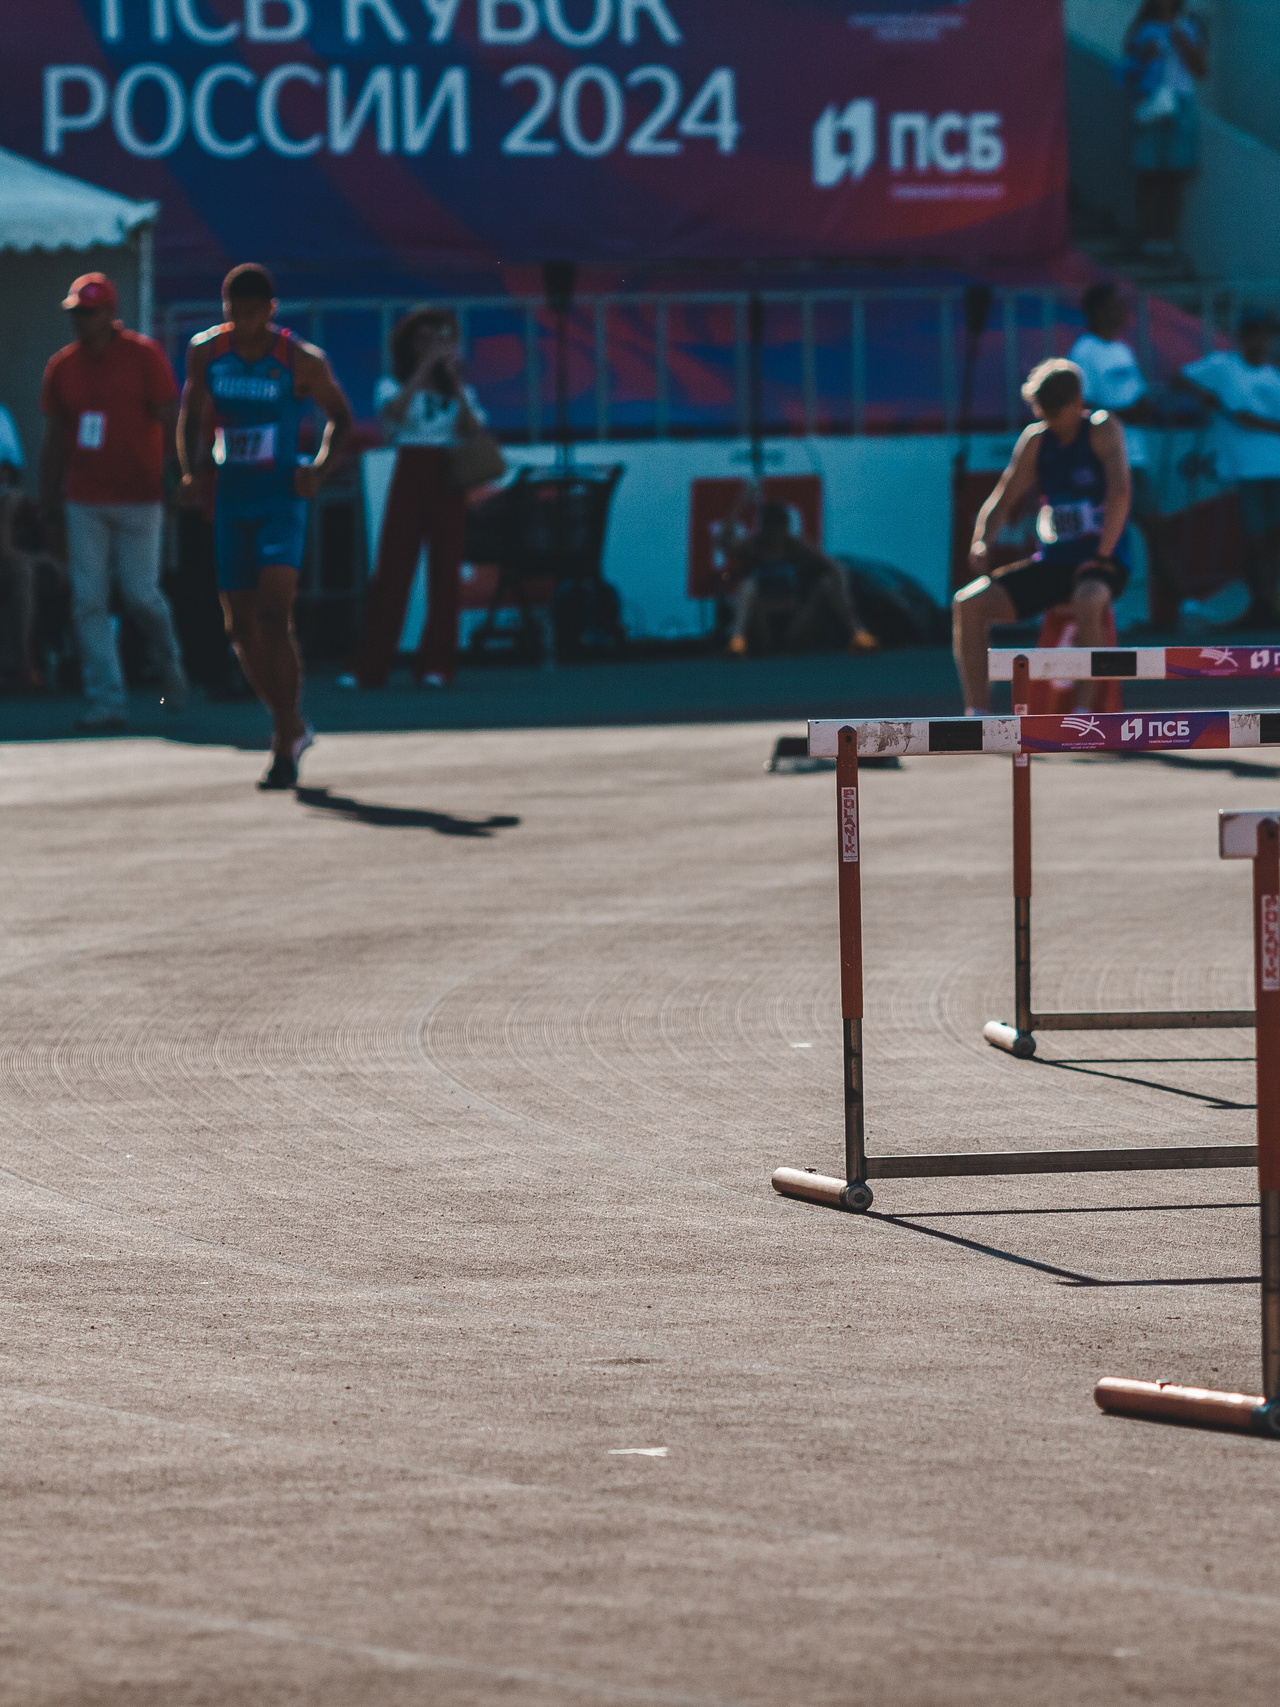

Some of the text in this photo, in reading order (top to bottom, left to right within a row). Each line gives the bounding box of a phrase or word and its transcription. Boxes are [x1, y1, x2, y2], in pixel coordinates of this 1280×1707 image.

[42, 63, 741, 157] РОССИИ 2024
[889, 111, 1004, 172] ПСБ
[1149, 721, 1190, 736] ПСБ
[843, 788, 856, 854] POLANIK
